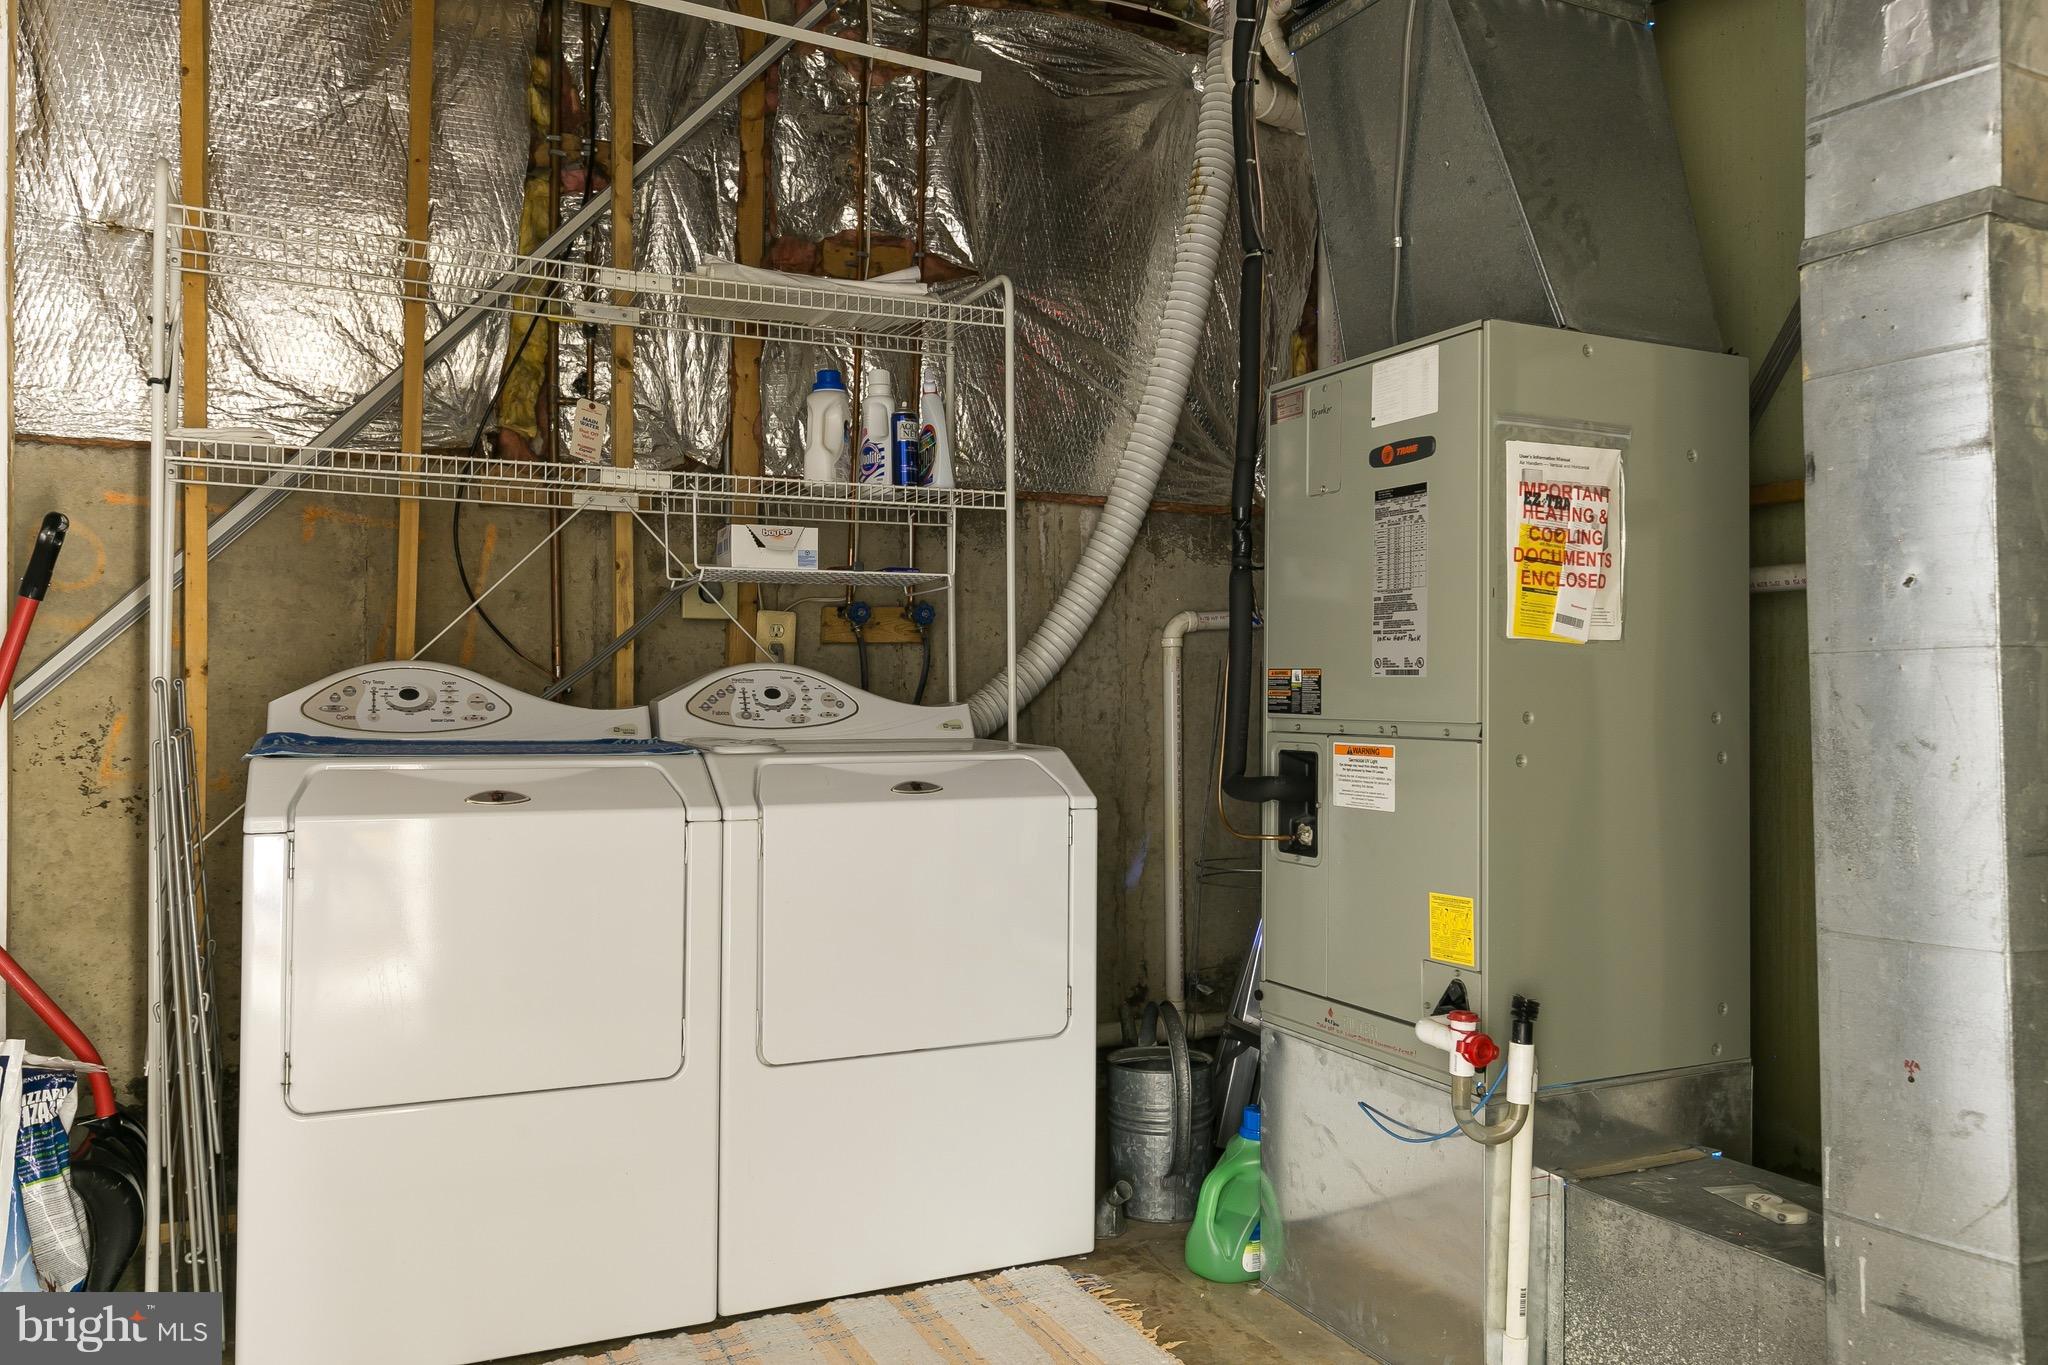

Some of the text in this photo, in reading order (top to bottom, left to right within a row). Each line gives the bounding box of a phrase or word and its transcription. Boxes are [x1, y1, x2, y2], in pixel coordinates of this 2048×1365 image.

[899, 422, 918, 430] AQU
[1518, 481, 1612, 503] IMPORTANT
[1523, 504, 1608, 524] HEATING &
[1529, 526, 1603, 546] COOLING
[1513, 547, 1613, 569] DOCUMENTS
[1521, 570, 1607, 589] ENCLOSED
[1353, 747, 1380, 756] WARNING
[22, 1087, 68, 1107] IZZARD
